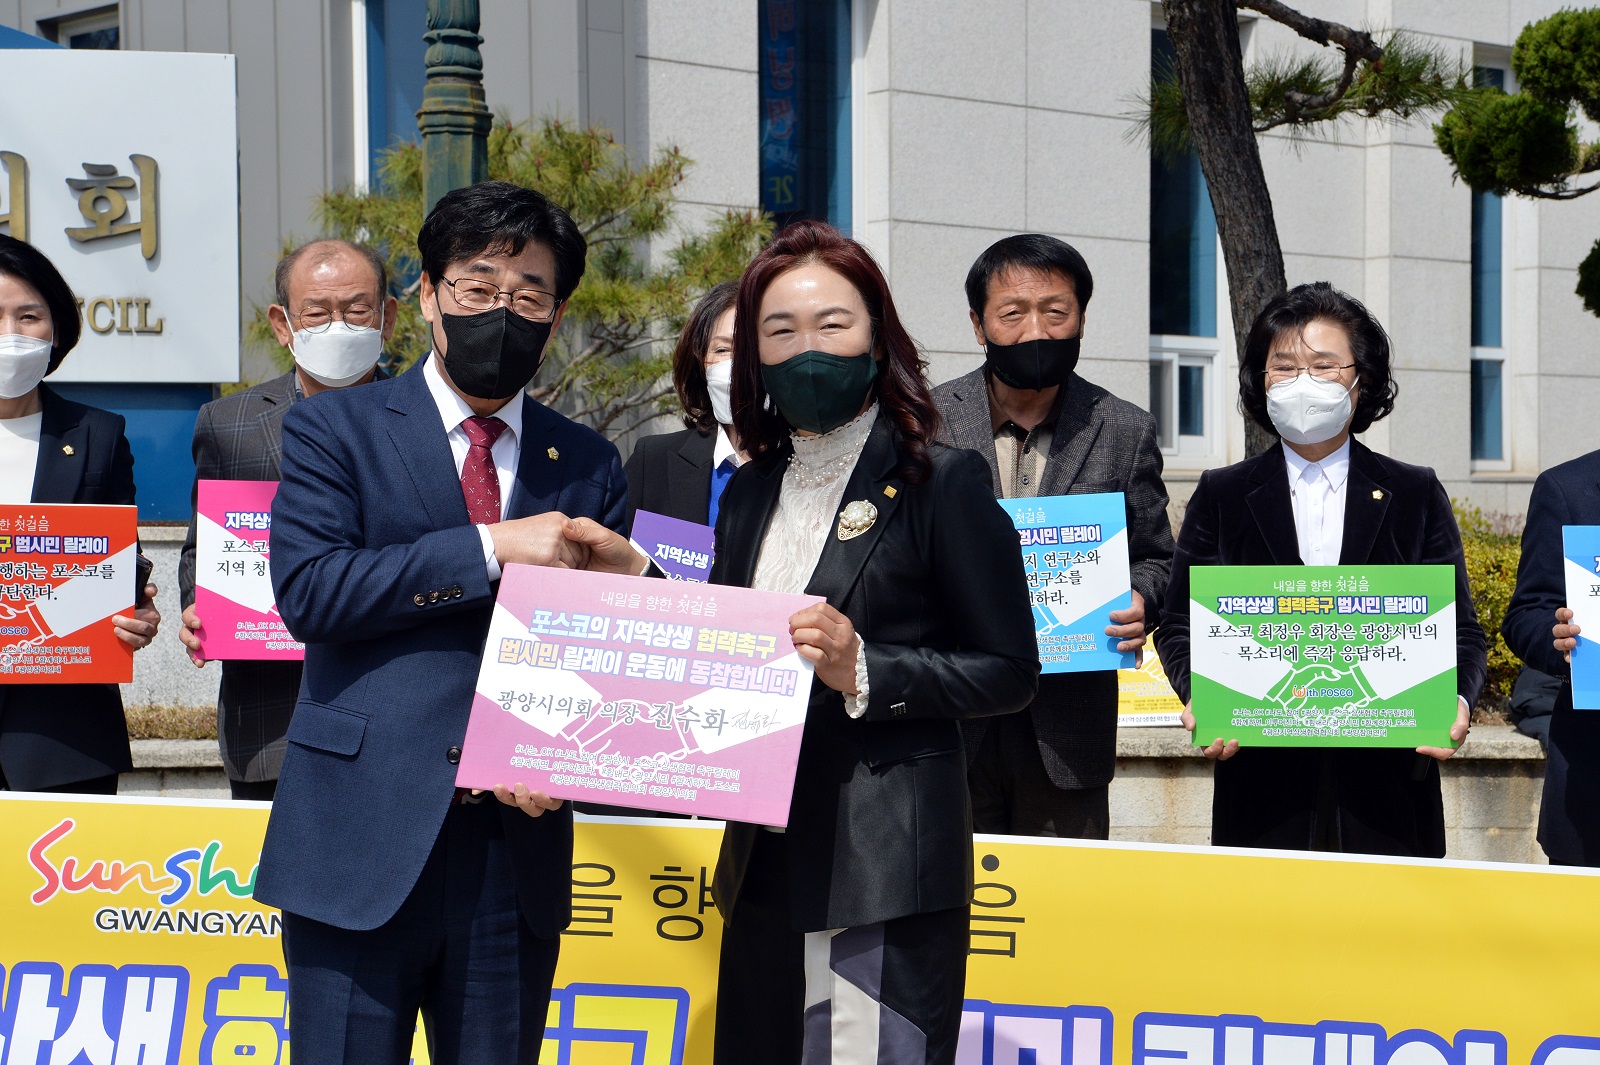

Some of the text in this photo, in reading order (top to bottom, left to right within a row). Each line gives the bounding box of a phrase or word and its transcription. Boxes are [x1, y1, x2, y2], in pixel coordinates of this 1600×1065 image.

[15, 518, 50, 532] 첫걸음
[225, 512, 271, 530] 지역상
[1015, 511, 1046, 525] 첫걸음
[1019, 524, 1102, 546] 범시민 릴레이
[15, 535, 60, 555] 범시민
[63, 536, 108, 555] 릴레이
[222, 541, 270, 553] 포스코
[654, 543, 709, 570] 지역상생
[1044, 549, 1101, 568] 연구소와
[52, 563, 116, 580] 포스코를
[217, 560, 245, 577] 지역
[1026, 569, 1083, 588] 연구소를
[1273, 579, 1370, 592] 내일을 향한 첫걸음
[601, 591, 718, 618] 내일을 향한 첫걸음
[1217, 596, 1428, 615] 지역상생 협력촉구 범시민 릴레이
[529, 609, 778, 661] 포스코의 지역상생 협력촉구
[1208, 623, 1438, 640] 포스코 최정우 회장은 광양시민의
[1238, 645, 1407, 662] 목소리에 즉각 응답하라.
[498, 637, 799, 697] 범시민 릴레이 운동에 동참합니다!
[1321, 688, 1354, 698] POSCO
[498, 690, 593, 720] 광양시의회
[600, 701, 640, 725] 의장
[649, 703, 729, 736] 진수화
[515, 744, 555, 758] #나는_OK
